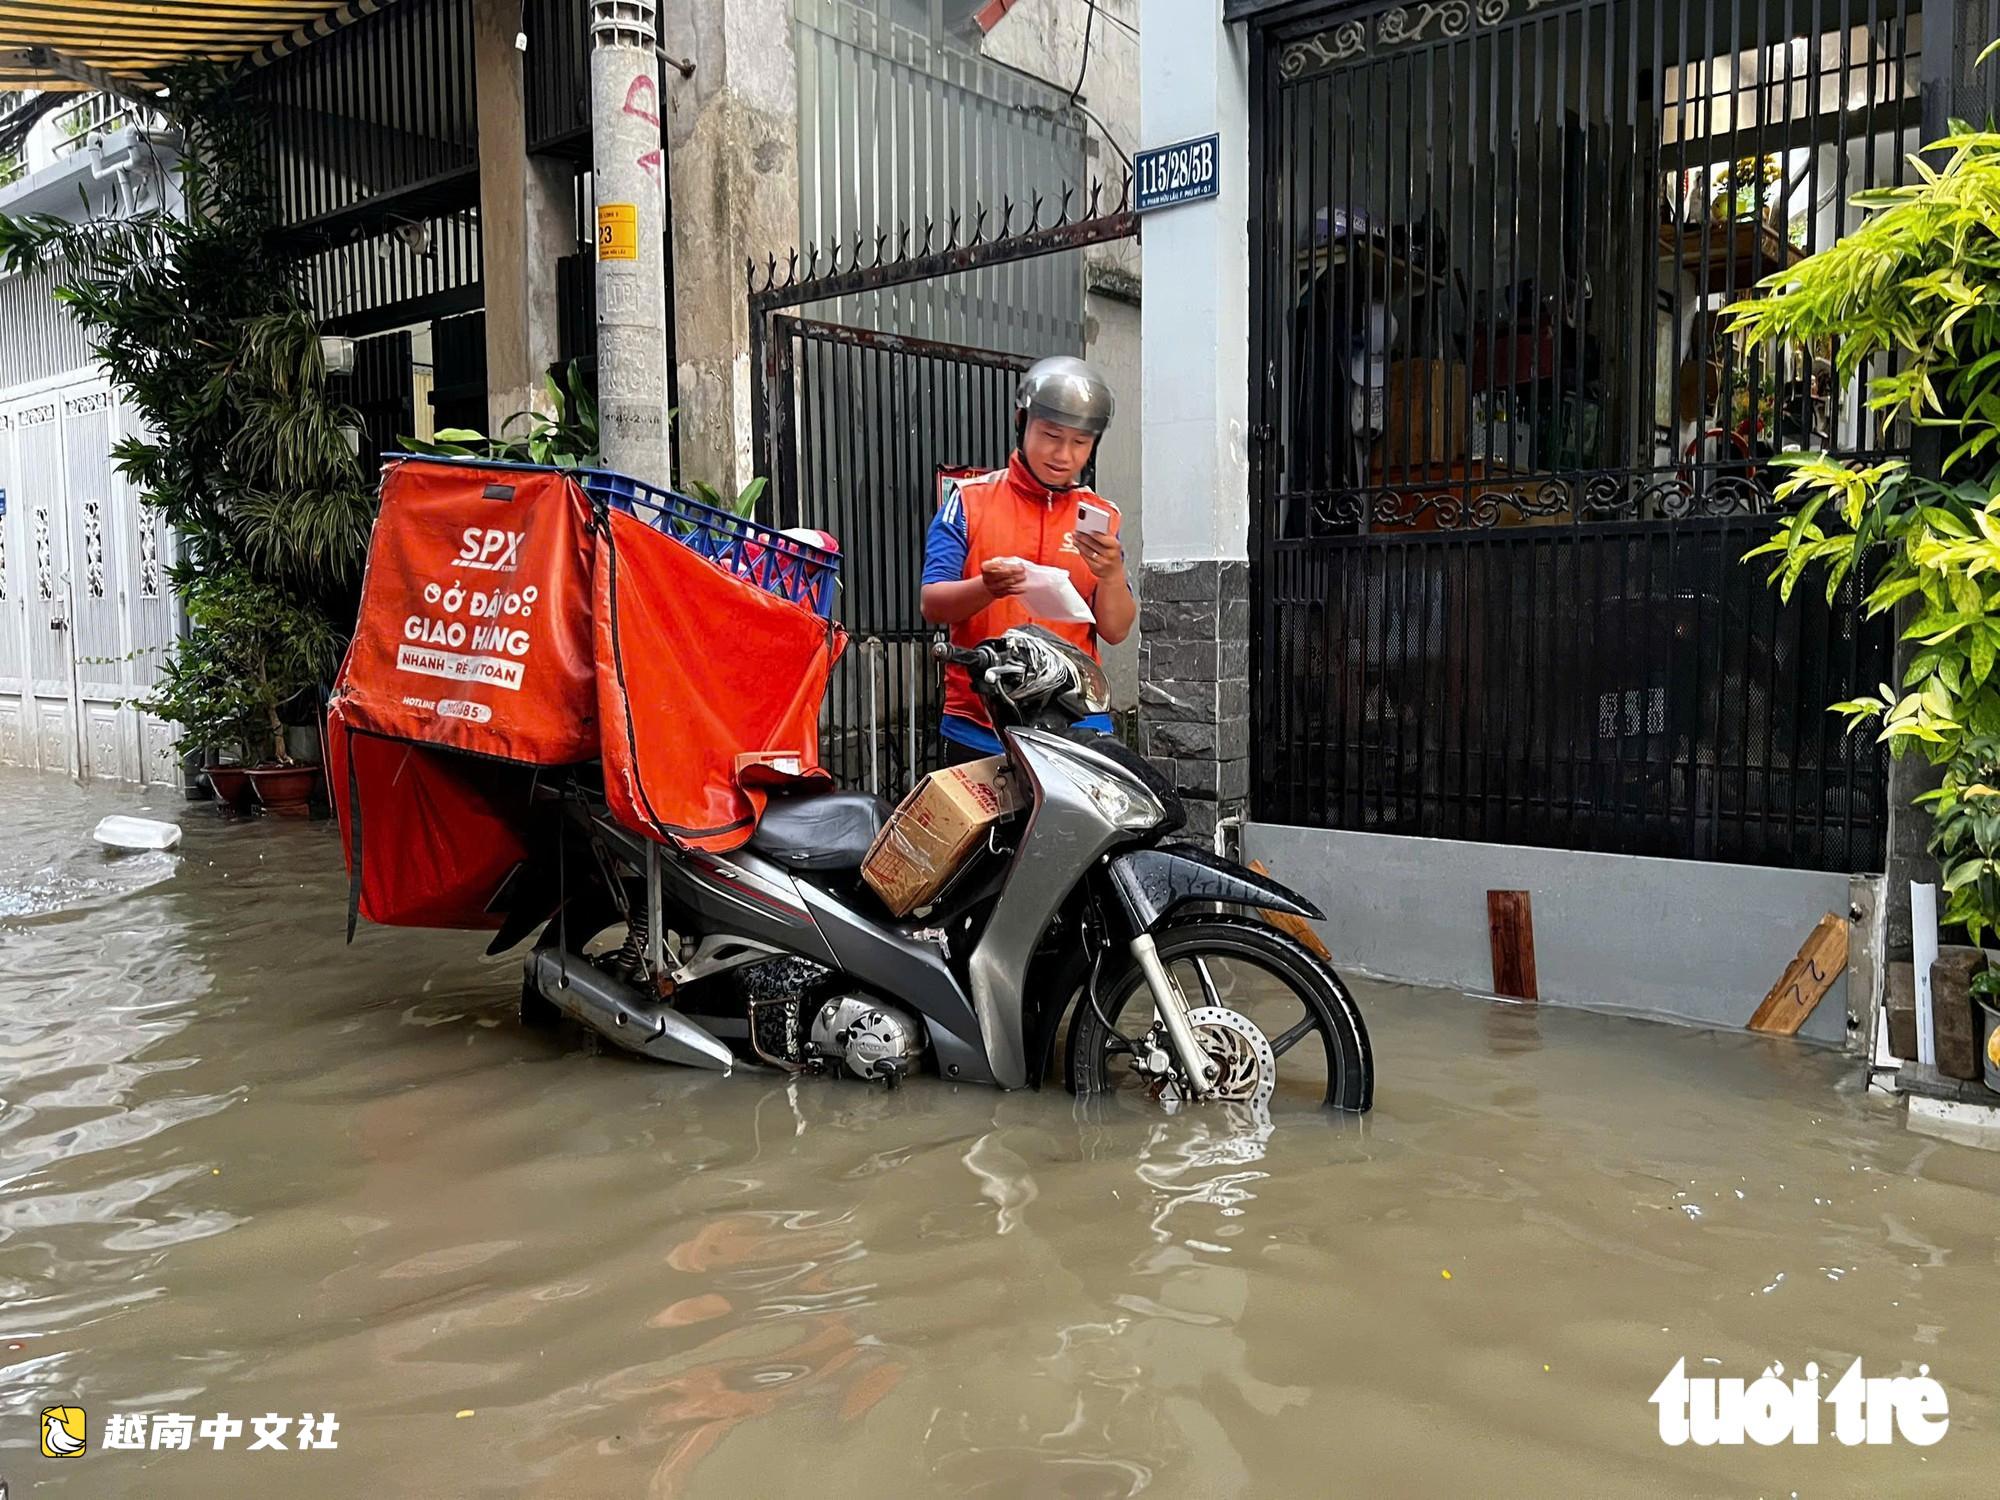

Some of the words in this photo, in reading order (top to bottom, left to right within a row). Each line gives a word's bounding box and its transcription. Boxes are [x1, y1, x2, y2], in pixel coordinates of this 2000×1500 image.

[1141, 142, 1213, 195] 115/28/5B
[459, 527, 525, 571] SPX
[442, 579, 466, 613] Ở
[404, 615, 466, 647] GIAO
[402, 652, 445, 671] NHANH
[480, 663, 516, 683] TOÀN
[403, 696, 436, 711] HOTLINE
